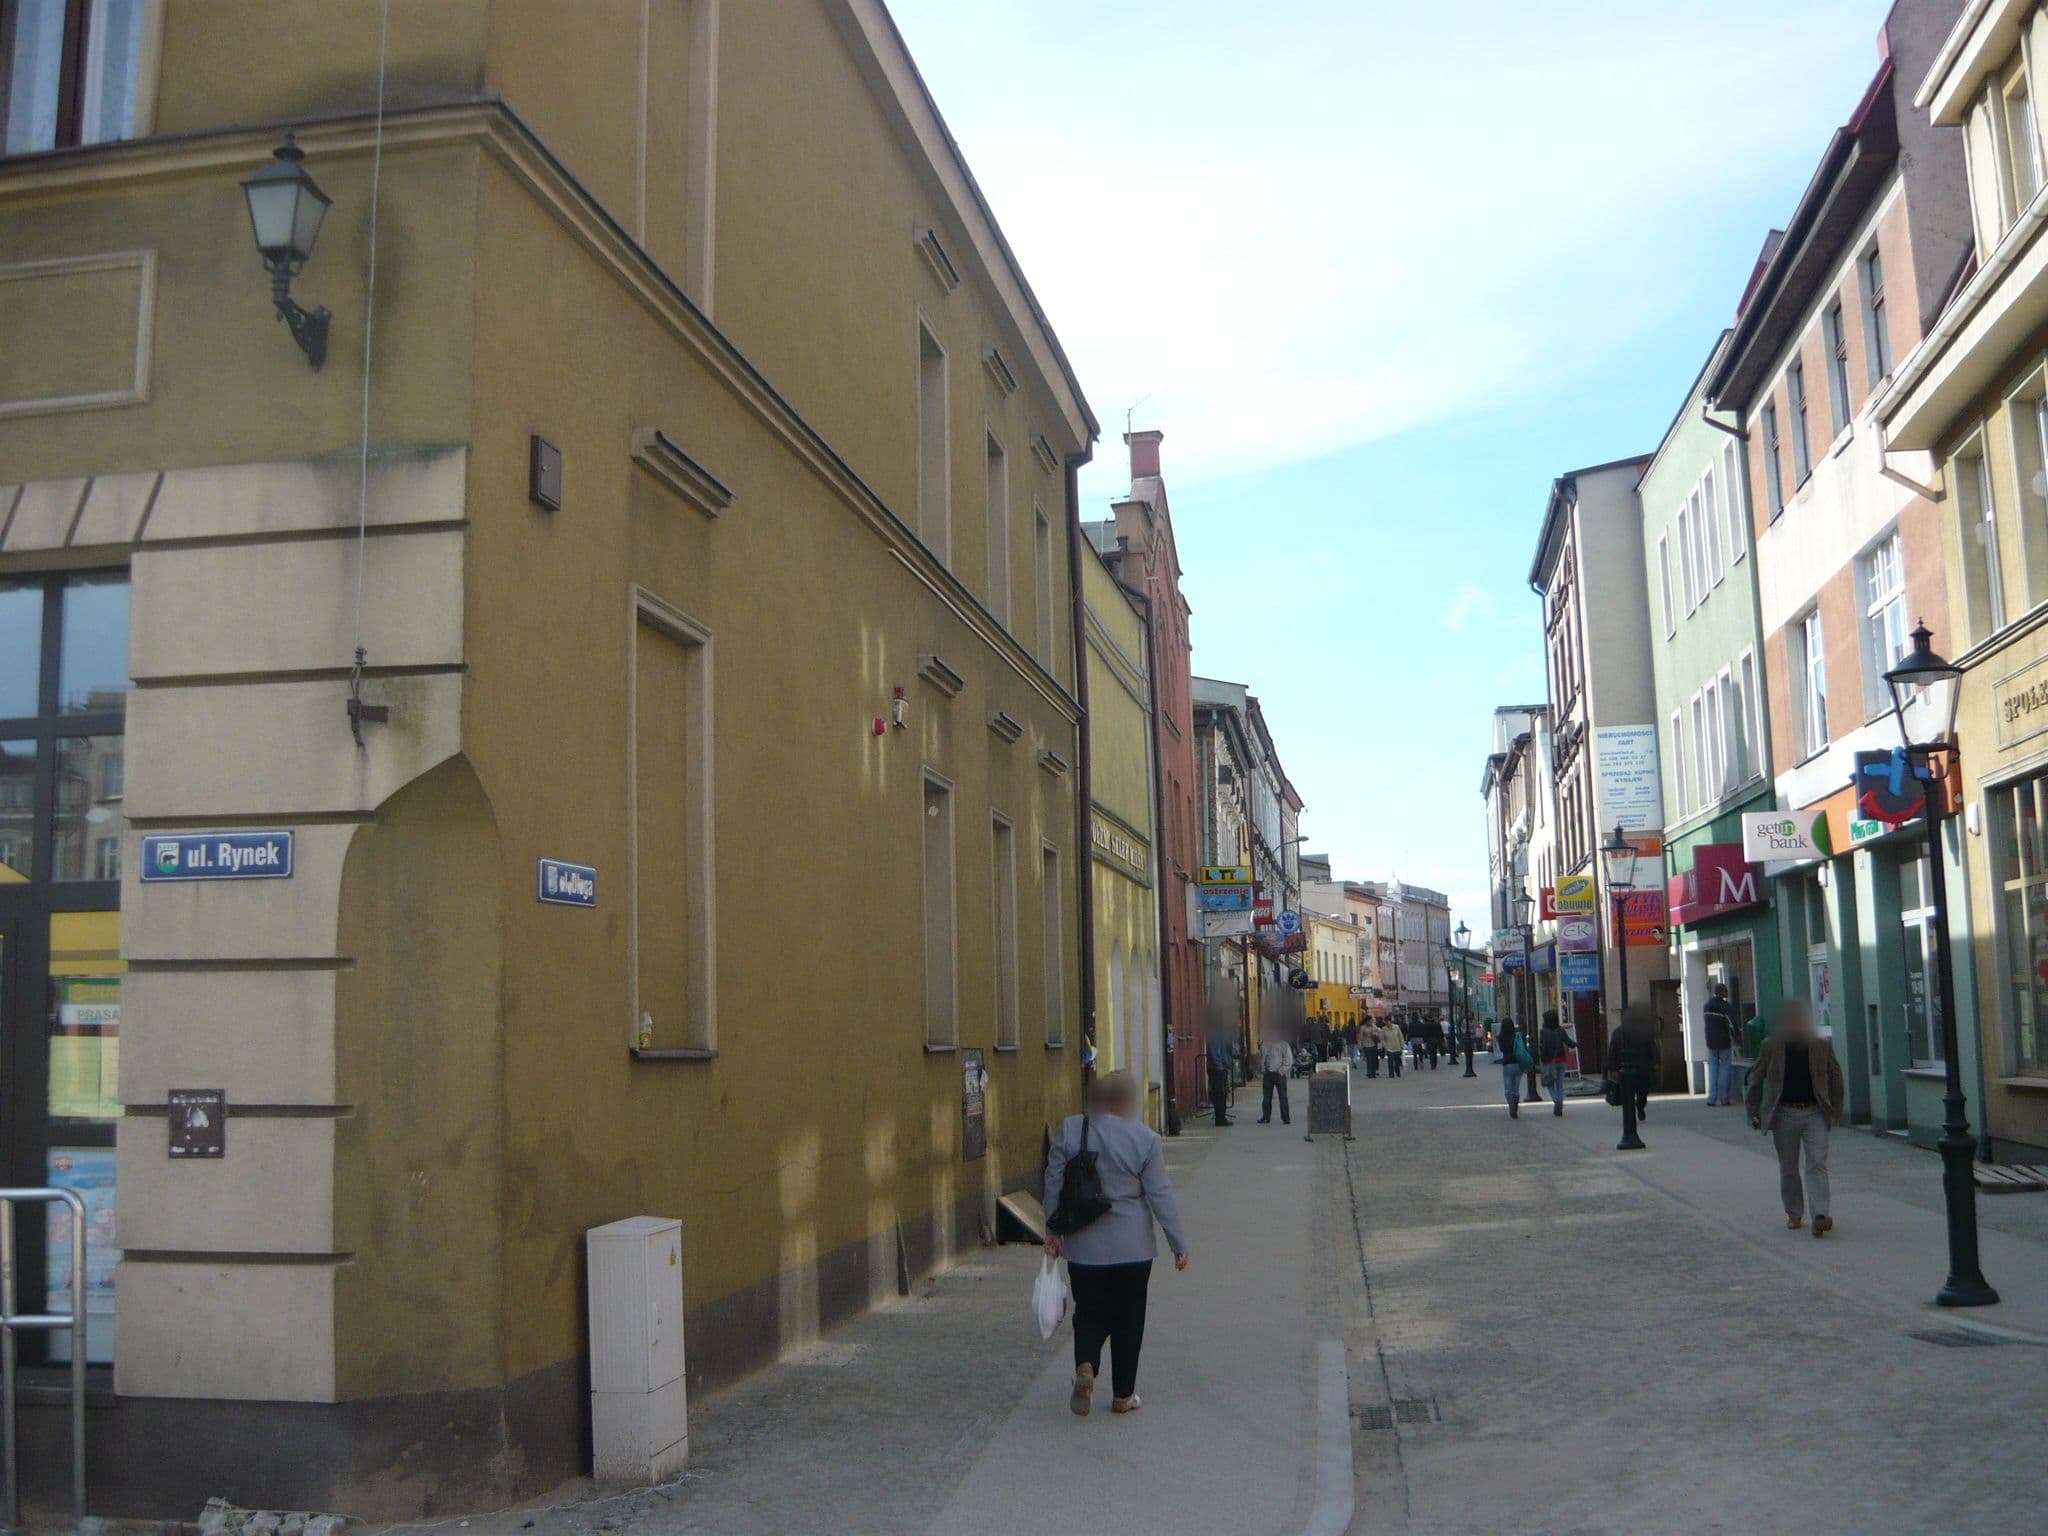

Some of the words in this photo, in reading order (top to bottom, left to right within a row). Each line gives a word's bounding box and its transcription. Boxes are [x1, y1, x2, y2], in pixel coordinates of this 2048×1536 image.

[2004, 680, 2048, 723] SPOŁE
[1757, 820, 1794, 837] getin
[1770, 835, 1808, 849] bank
[187, 843, 213, 868] ul.
[218, 841, 280, 872] Rynek
[1205, 869, 1247, 881] LOTTO
[1203, 887, 1249, 896] ostrzenie
[1712, 866, 1757, 904] M
